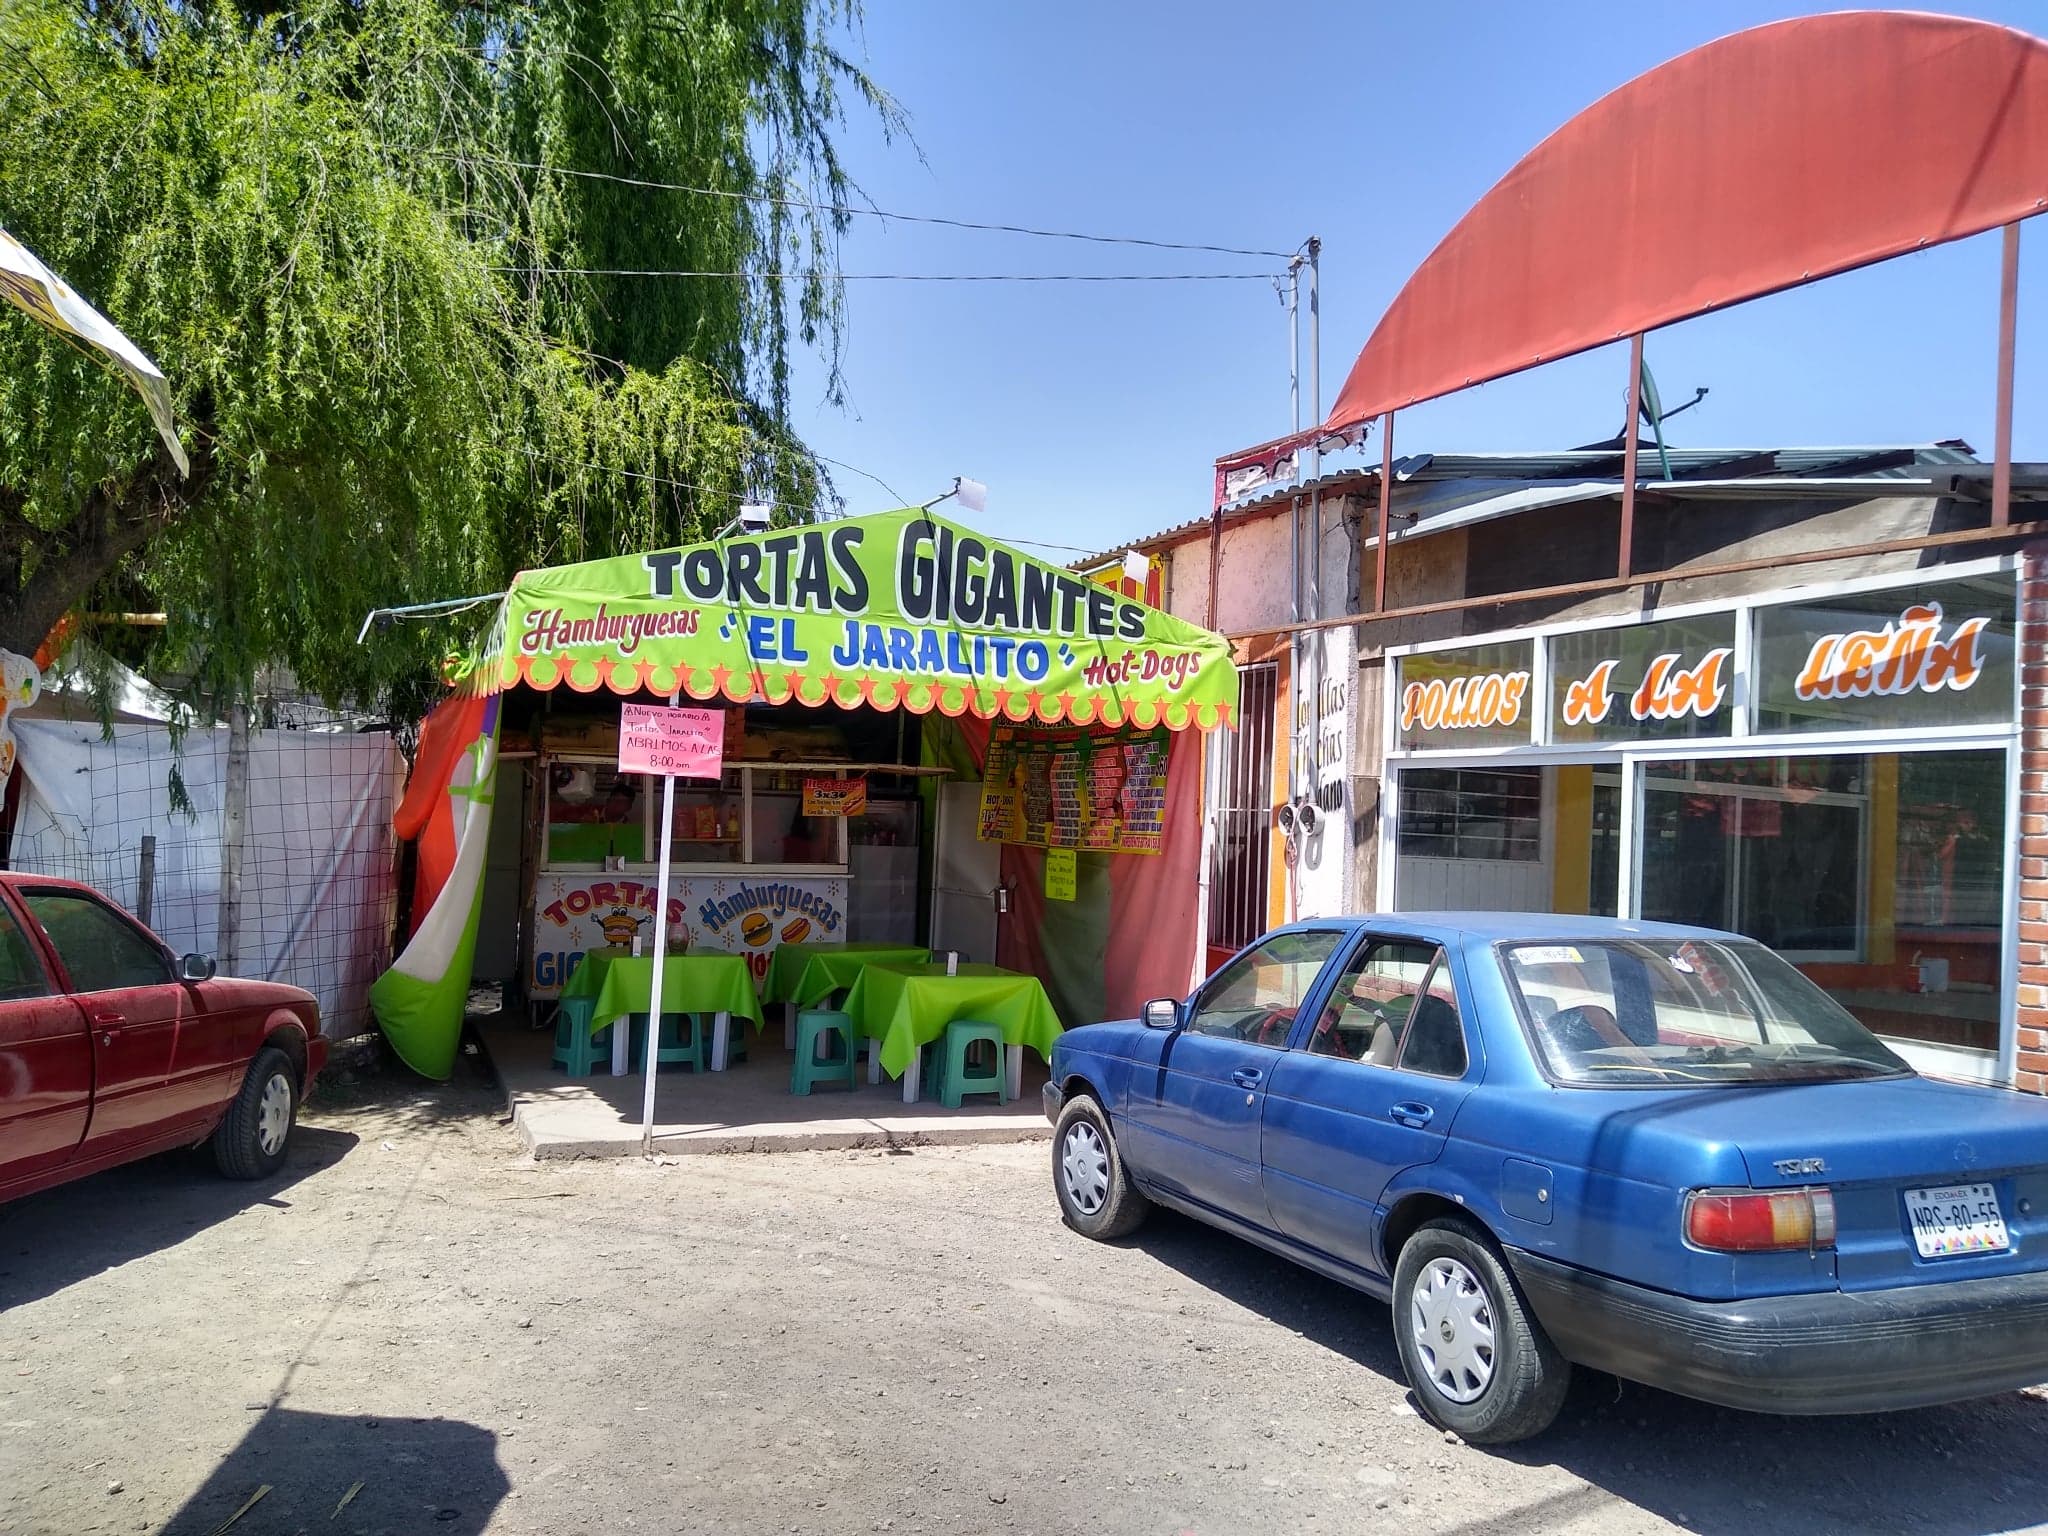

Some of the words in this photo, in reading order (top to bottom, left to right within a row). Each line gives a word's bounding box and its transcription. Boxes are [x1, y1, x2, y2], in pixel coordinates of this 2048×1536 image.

[646, 526, 869, 614] TORTAS
[899, 519, 1146, 640] GIGANTES
[522, 603, 699, 657] Hamburguesas
[1082, 647, 1202, 691] Hot-Dogs
[1401, 671, 1530, 731] POLLOS
[1563, 660, 1620, 726] A
[1631, 648, 1734, 721] LA
[1795, 601, 1991, 701] LEÑA
[627, 737, 687, 752] ABRIMOS
[650, 755, 673, 767] 8:00
[543, 881, 686, 928] TORTAS
[700, 881, 842, 934] Hamburguesas
[1913, 1202, 2000, 1235] NRS-80-55
